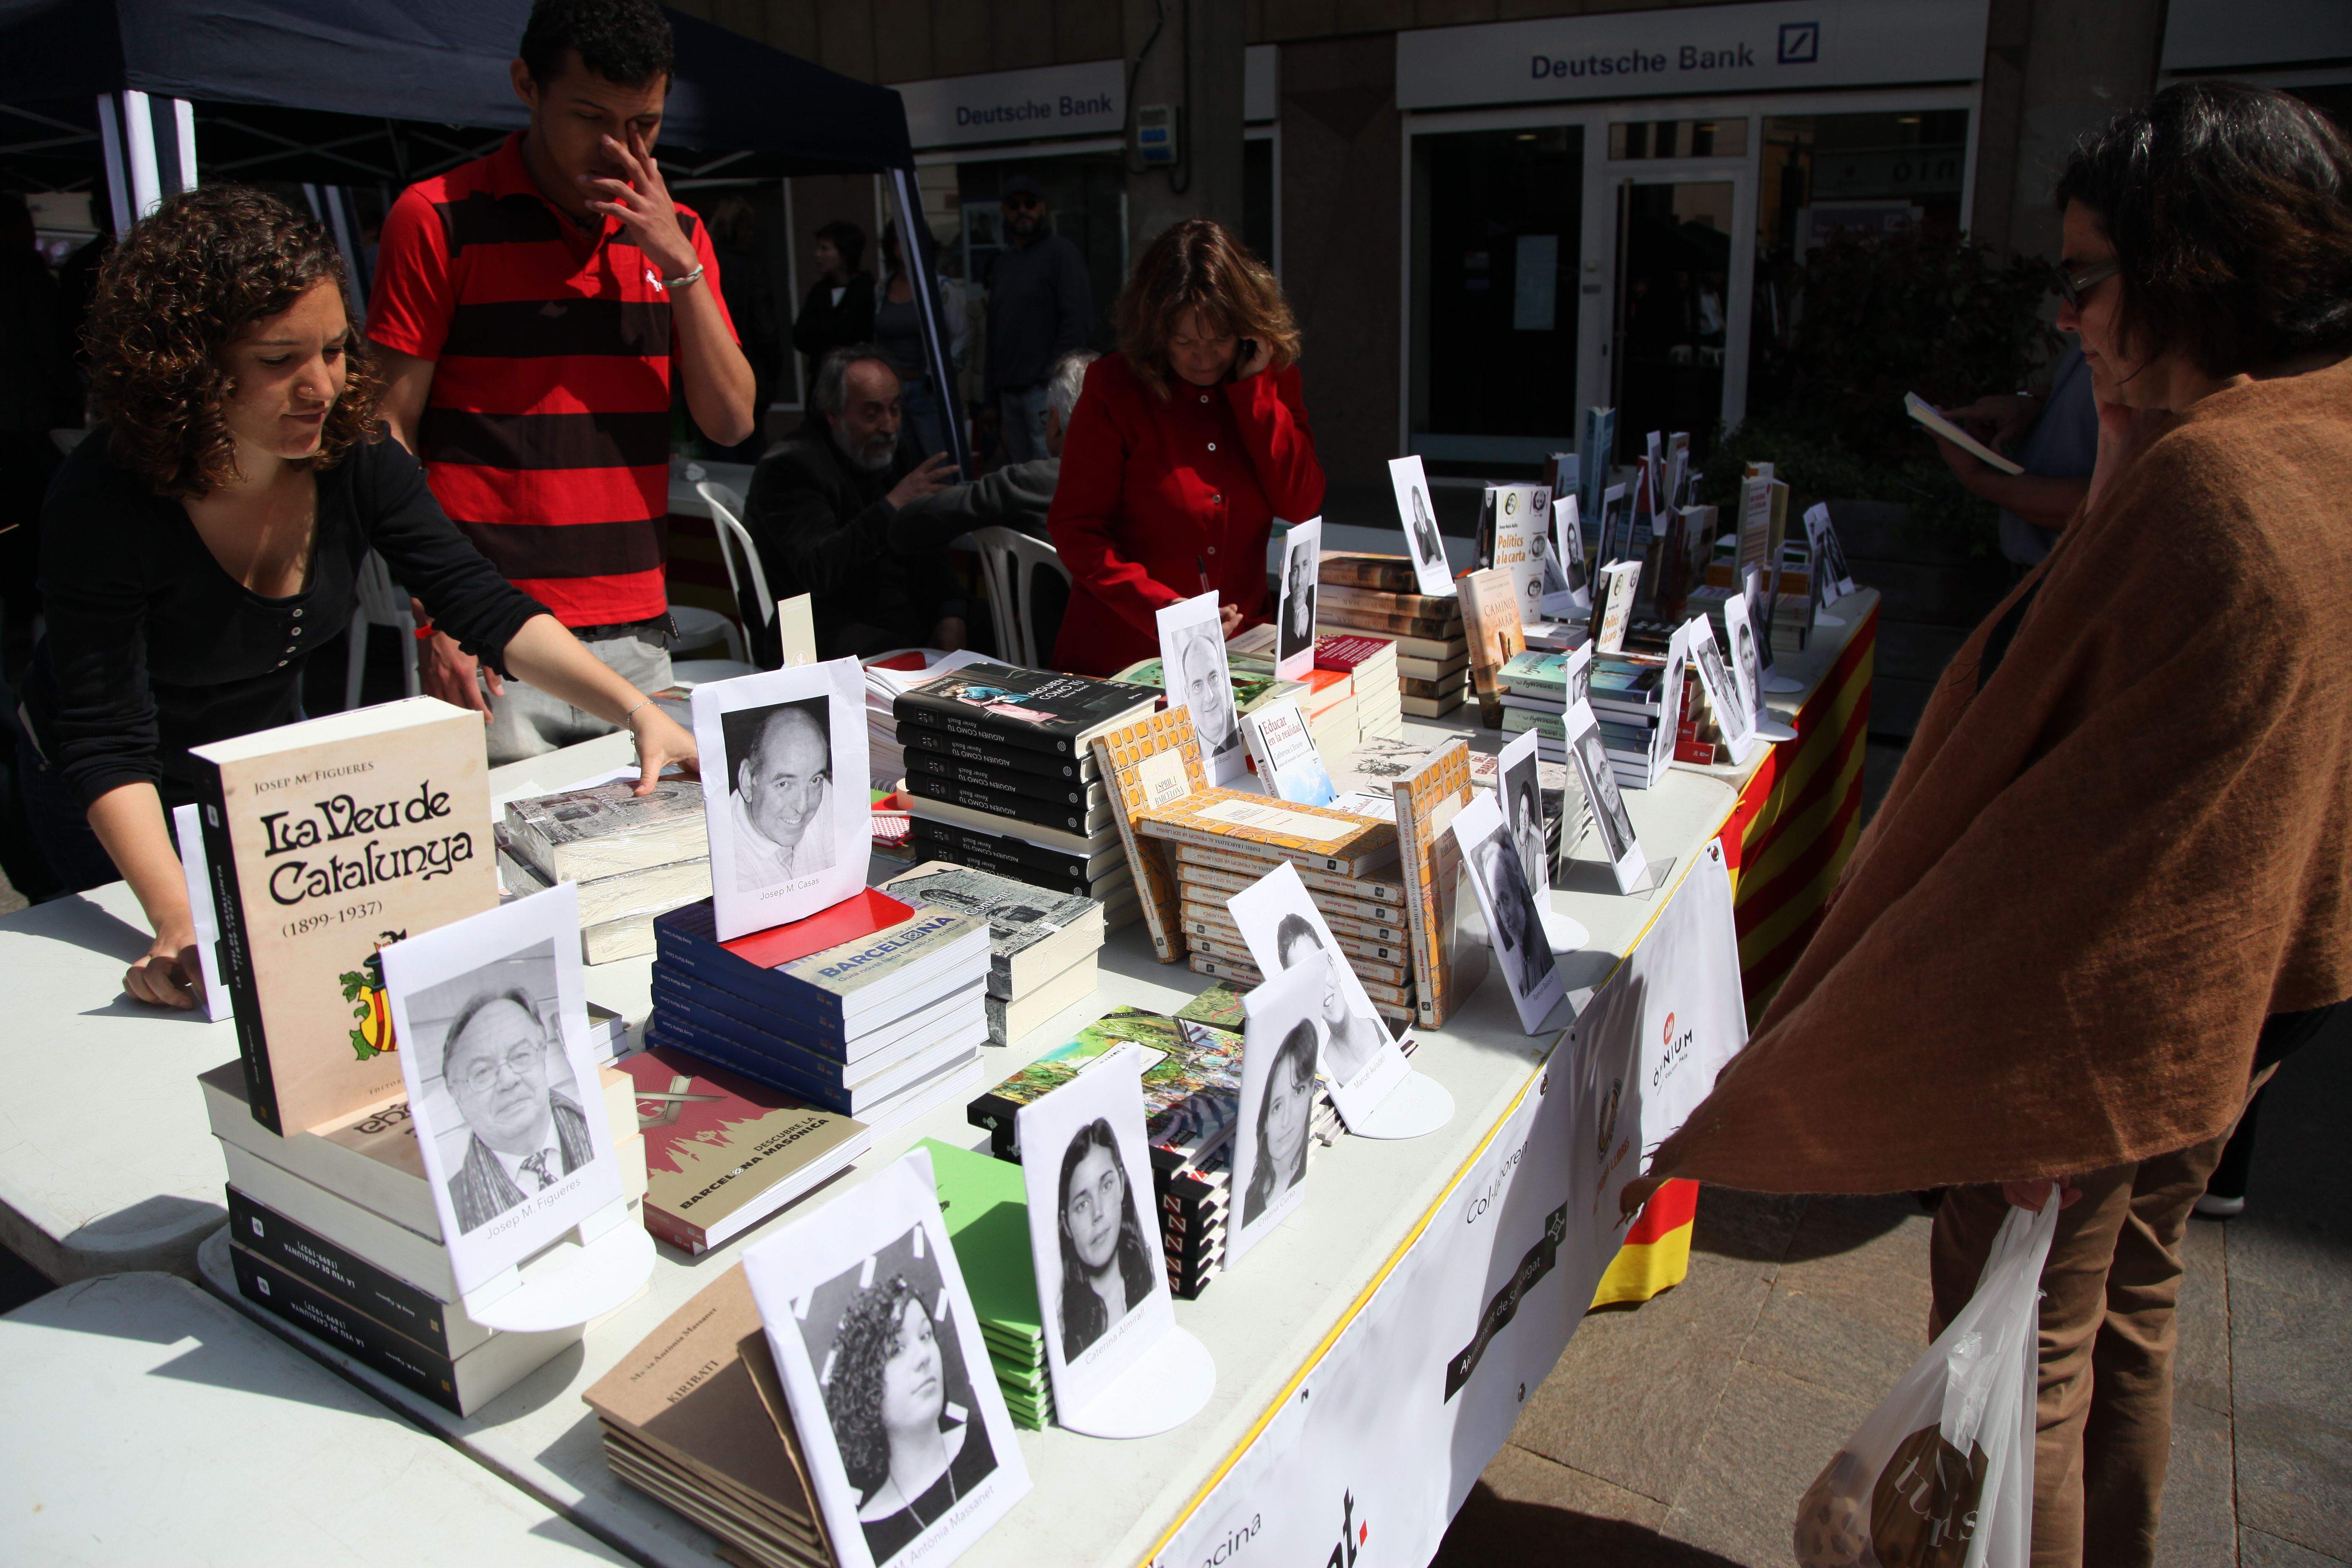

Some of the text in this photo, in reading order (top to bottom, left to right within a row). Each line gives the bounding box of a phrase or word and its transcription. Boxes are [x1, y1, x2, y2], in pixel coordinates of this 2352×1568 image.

[1532, 43, 1755, 80] Deutsche Bank
[956, 93, 1113, 126] Deutsche Bank
[1508, 550, 1526, 563] carta
[1484, 597, 1516, 617] CAMINOS
[1498, 613, 1515, 629] MAR
[1027, 678, 1068, 697] ALGUIEN
[1039, 685, 1073, 700] COMO
[947, 717, 977, 729] Xavier Bosch
[956, 726, 977, 737] COMO
[1261, 716, 1287, 735] Educar
[978, 731, 1005, 742] ALGUIEN
[1267, 721, 1302, 747] en la realidad
[952, 742, 966, 750] Bosch
[961, 751, 982, 761] COMO
[984, 756, 1011, 766] ALGUIEN
[1204, 753, 1232, 770] Xavier Bosch
[254, 761, 374, 795] JOSEP M. FIGUERES
[1155, 777, 1173, 792] ESPRIU
[1261, 765, 1271, 784] Educar
[1154, 785, 1185, 806] BARCELONA
[601, 798, 630, 817] Convent
[260, 779, 451, 858] La Veu de
[1188, 833, 1207, 841] PRINCIPI
[1215, 839, 1241, 849] BARCELONA
[268, 831, 475, 906] Catalunya
[760, 877, 820, 901] Josep M. Casas
[1323, 878, 1341, 887] Balasch
[964, 890, 1013, 916] Convent
[282, 900, 383, 939] (1899-1937)
[867, 915, 936, 947] UNA PASSEJADA PER
[838, 972, 860, 983] Guia
[938, 920, 969, 936] cultural
[1245, 974, 1262, 983] Balasch
[1353, 1053, 1387, 1089] Maricel Auladell
[753, 1116, 817, 1152] DESCUBRE LA
[763, 1118, 830, 1156] MASÓNICA
[487, 1178, 581, 1239] Josep M. Figueres
[1258, 1189, 1296, 1228] Cristina Curto
[284, 1243, 320, 1269] CATALUNYA
[332, 1268, 345, 1282] VEU
[1496, 1300, 1508, 1316] de
[682, 1308, 717, 1336] Massanet
[1085, 1307, 1146, 1364] Caterina Almirall
[667, 1360, 720, 1403] KIRIBATI
[910, 1528, 950, 1563] Antònia
[949, 1485, 995, 1528] Massanet
[1202, 1512, 1261, 1568] ocina
